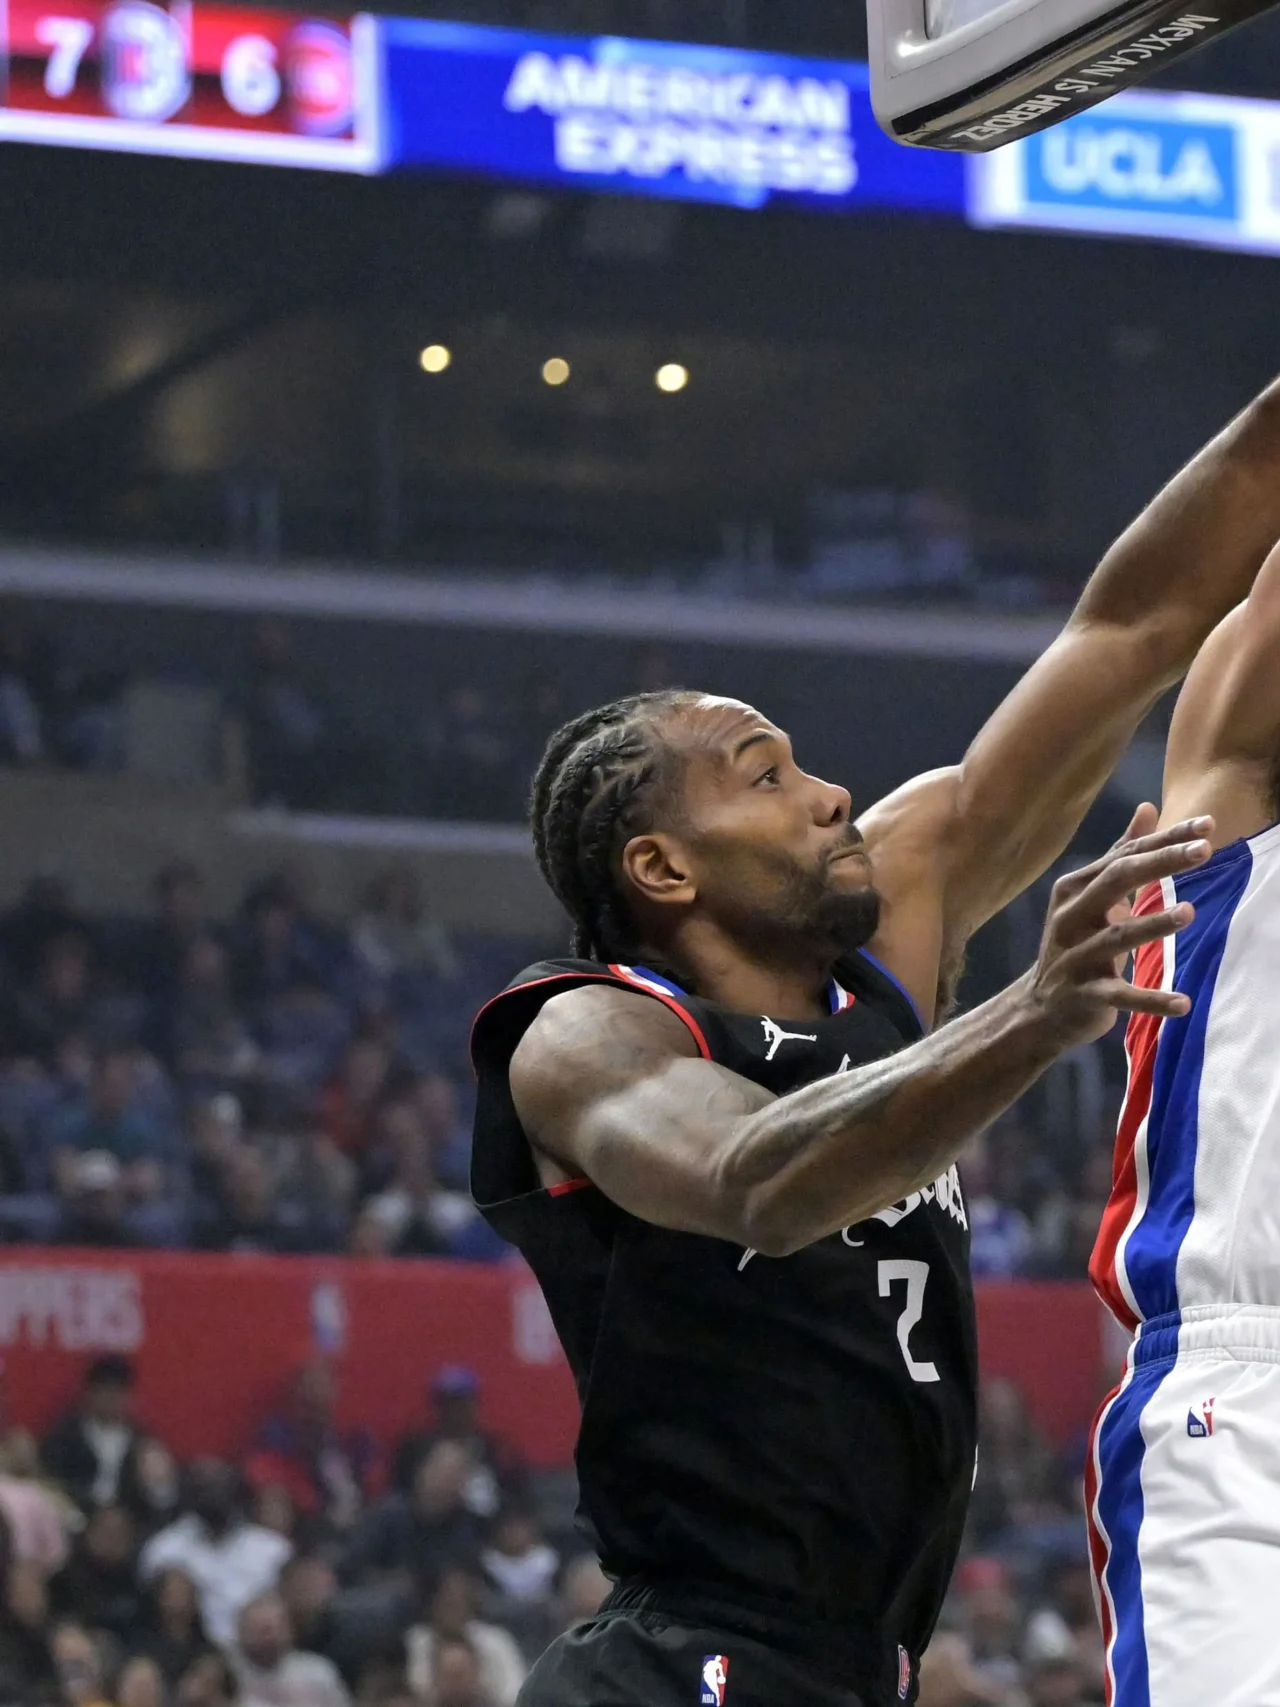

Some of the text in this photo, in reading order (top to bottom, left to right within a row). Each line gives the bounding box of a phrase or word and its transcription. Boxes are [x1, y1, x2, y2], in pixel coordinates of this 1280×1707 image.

[35, 16, 94, 98] 7
[221, 33, 281, 117] 6
[504, 51, 851, 132] AMERICAN
[1055, 78, 1099, 93] IS
[554, 110, 858, 195] EXPRESS
[952, 94, 1072, 141] HERDEZ
[1040, 125, 1224, 201] UCLA
